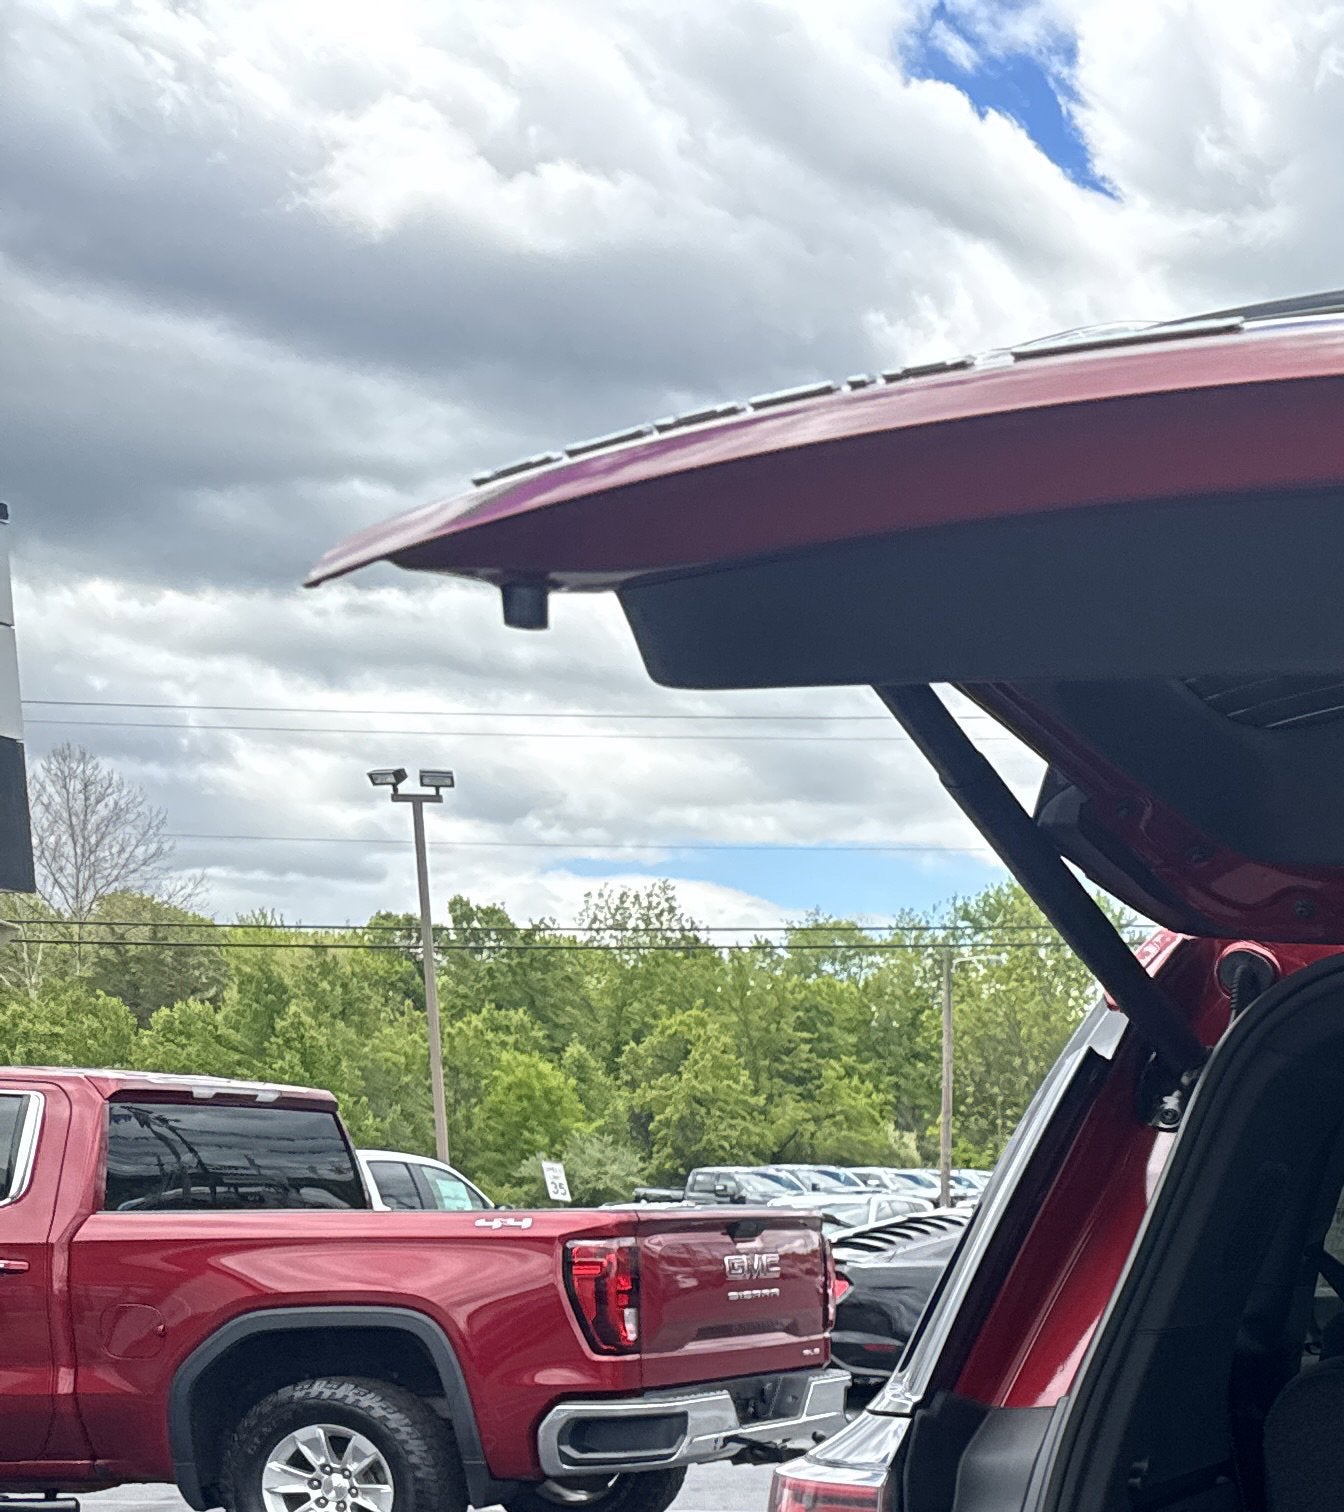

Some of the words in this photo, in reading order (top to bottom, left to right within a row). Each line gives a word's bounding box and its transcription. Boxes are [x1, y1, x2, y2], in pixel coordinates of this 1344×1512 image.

[550, 1181, 567, 1197] 35
[723, 1253, 781, 1280] GMC
[727, 1287, 780, 1301] SIERRA
